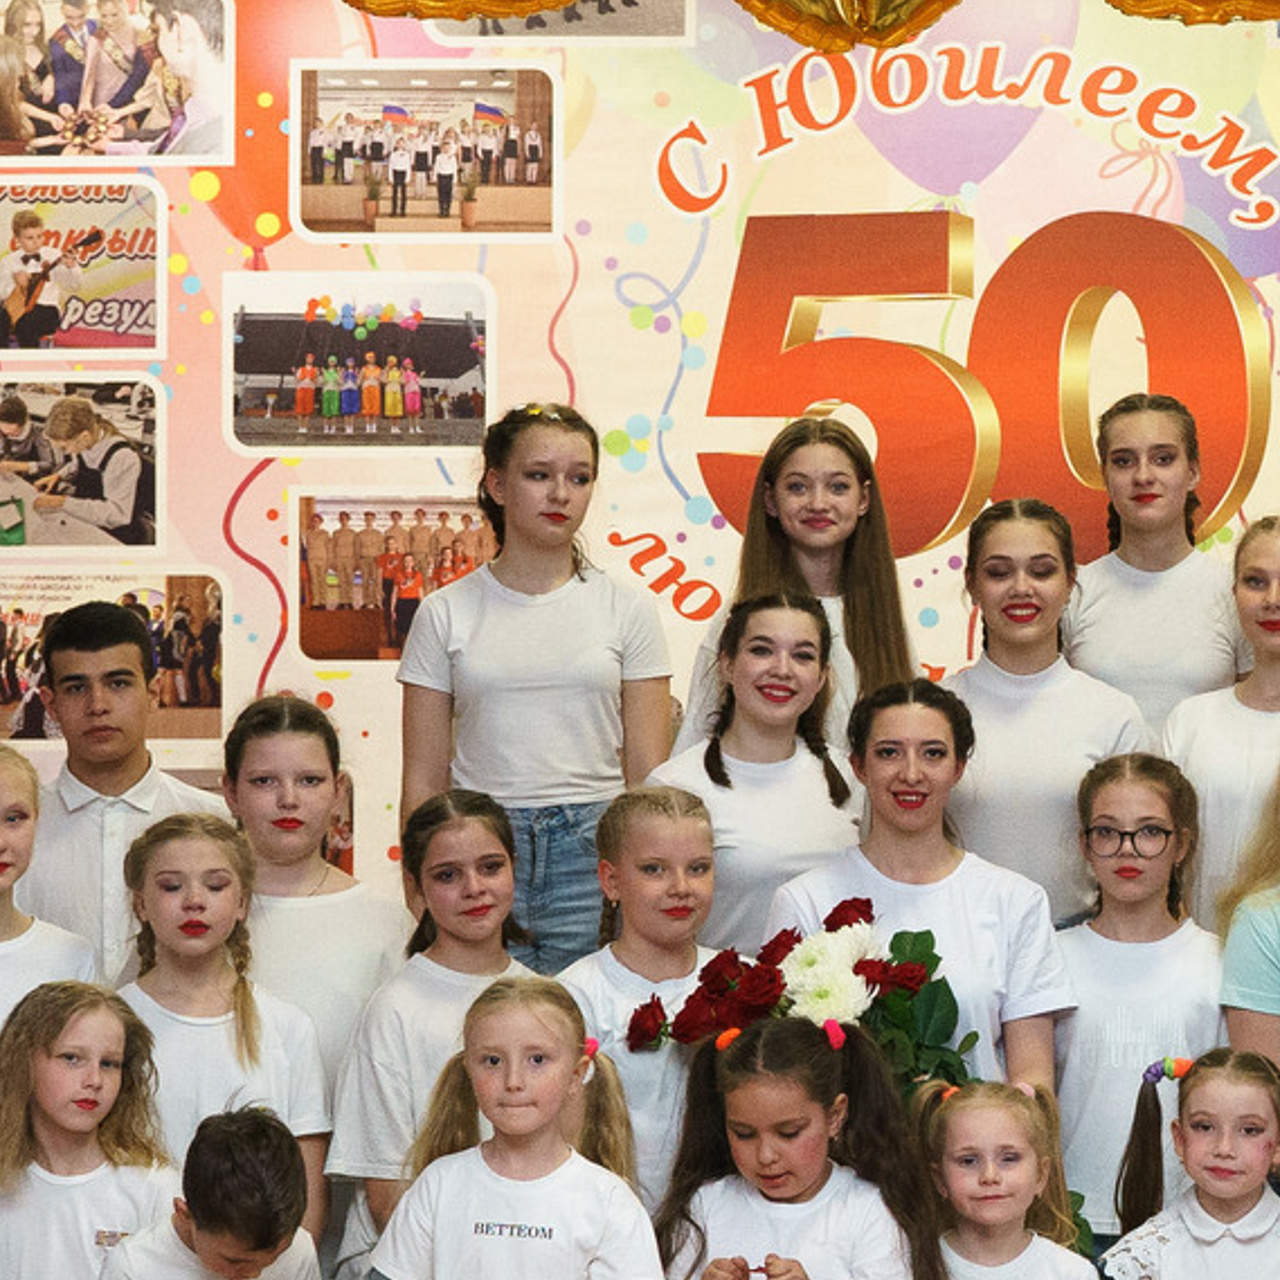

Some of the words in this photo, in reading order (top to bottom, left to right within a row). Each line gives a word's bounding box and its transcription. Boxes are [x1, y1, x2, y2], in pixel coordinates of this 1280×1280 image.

[658, 121, 728, 213] С
[744, 34, 1277, 224] Юбилеем,
[0, 184, 127, 202] емени
[696, 210, 1273, 564] 50
[473, 1221, 553, 1239] BETTEOM
